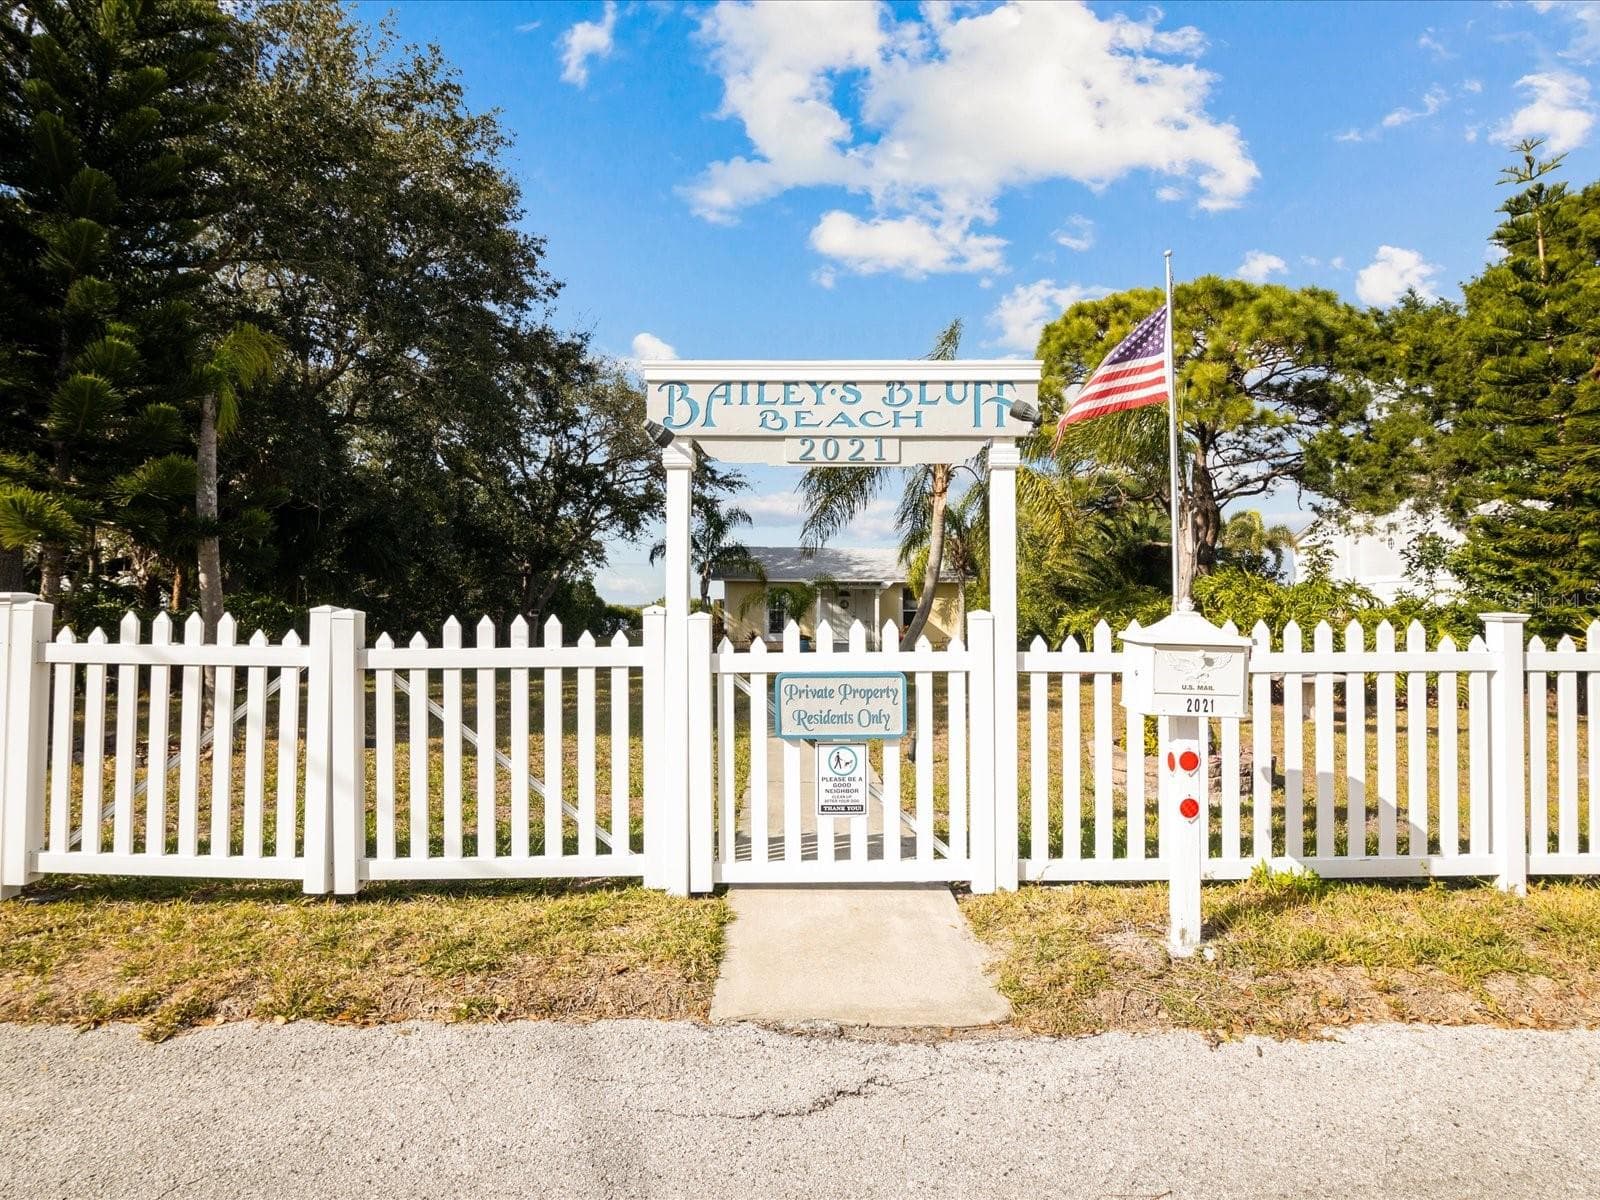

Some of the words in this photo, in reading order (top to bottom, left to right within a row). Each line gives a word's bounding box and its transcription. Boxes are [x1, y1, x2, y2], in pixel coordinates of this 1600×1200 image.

[882, 380, 1016, 428] BLUFF
[758, 409, 924, 432] BEACH
[799, 436, 886, 461] 2021
[784, 684, 835, 706] Private
[838, 683, 898, 706] Property
[1186, 698, 1214, 713] 2021
[792, 709, 854, 732] Residents
[857, 708, 891, 732] Only
